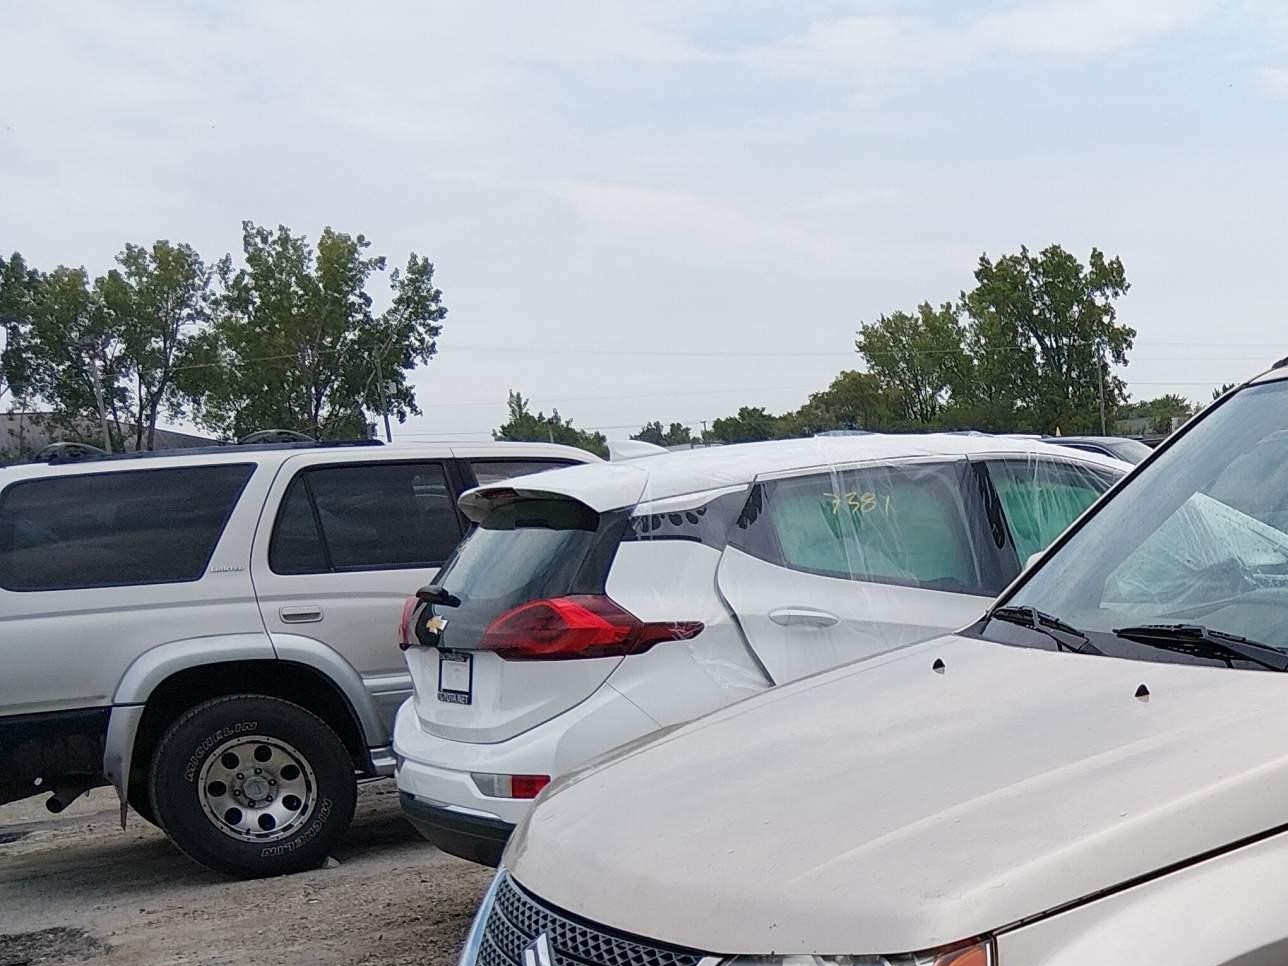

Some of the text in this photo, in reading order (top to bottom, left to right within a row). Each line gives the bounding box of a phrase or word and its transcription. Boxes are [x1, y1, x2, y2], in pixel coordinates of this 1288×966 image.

[823, 491, 890, 516] 7381
[184, 721, 258, 783] MICHELIN
[261, 799, 333, 857] MICHELIN
